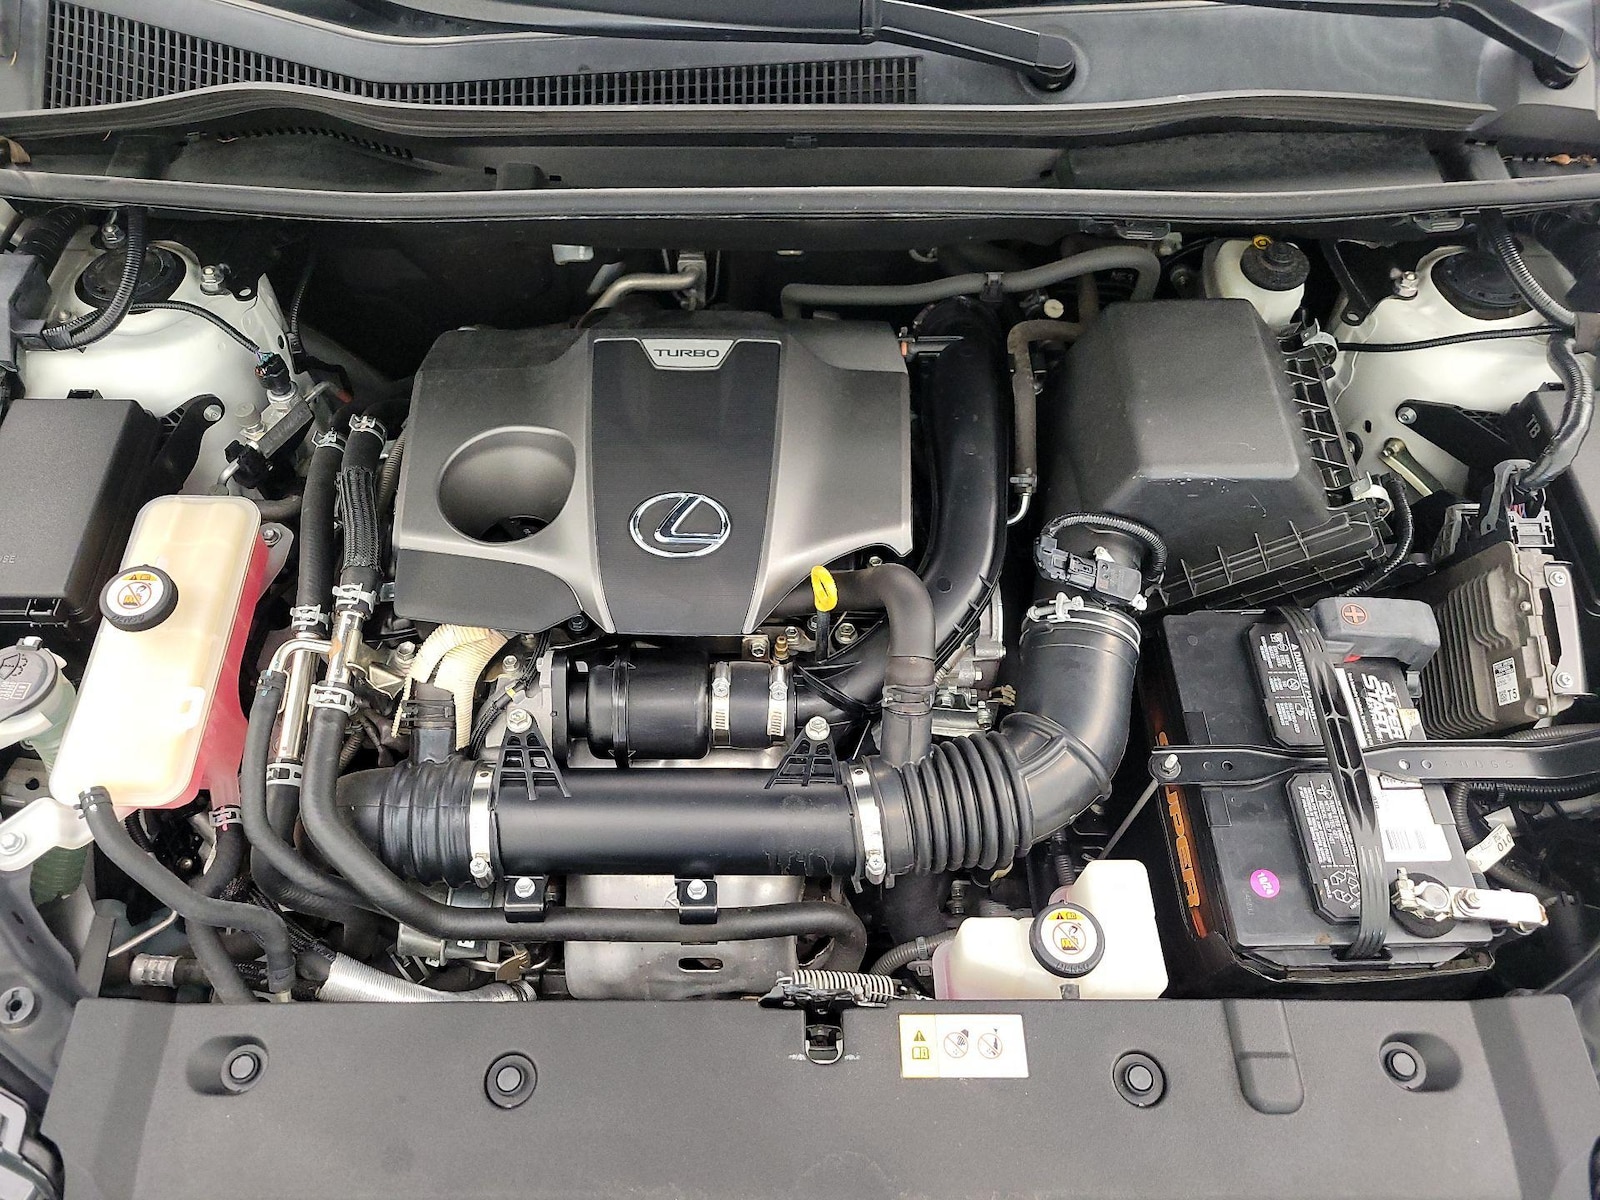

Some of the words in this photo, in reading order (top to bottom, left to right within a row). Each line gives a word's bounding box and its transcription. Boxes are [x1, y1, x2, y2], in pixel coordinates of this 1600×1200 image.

[653, 349, 720, 358] TURBO
[1293, 651, 1309, 685] DANGER
[1361, 673, 1394, 741] START
[1380, 680, 1405, 739] SUPER
[1507, 688, 1518, 701] T5
